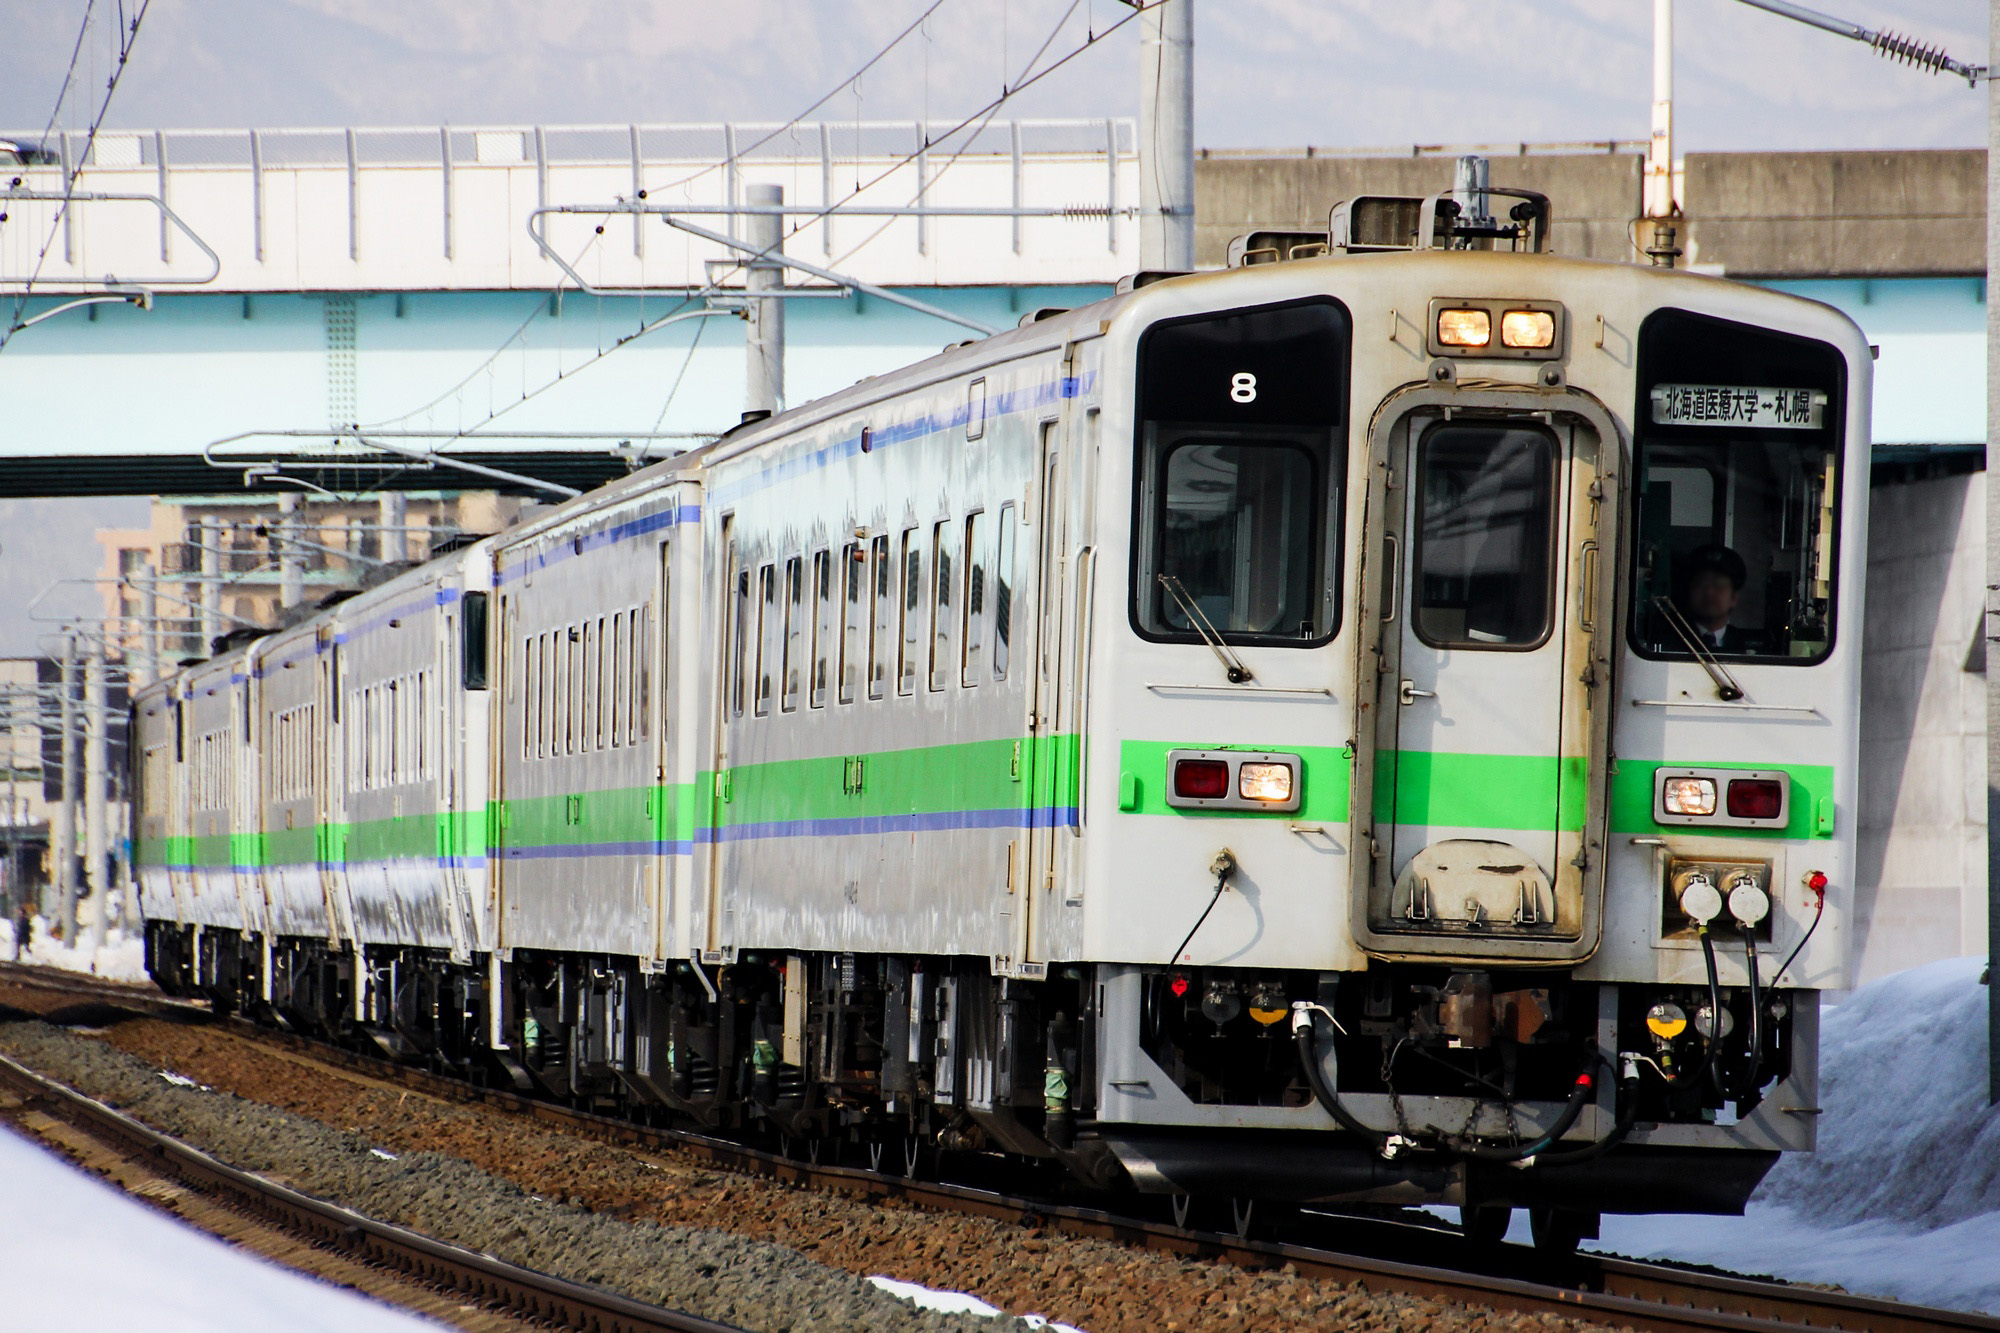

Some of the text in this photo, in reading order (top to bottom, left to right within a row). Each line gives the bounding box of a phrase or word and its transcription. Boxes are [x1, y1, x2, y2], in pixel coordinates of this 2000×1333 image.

[1230, 372, 1257, 404] 8
[1665, 386, 1811, 424] 北海道医療大学 札幌
